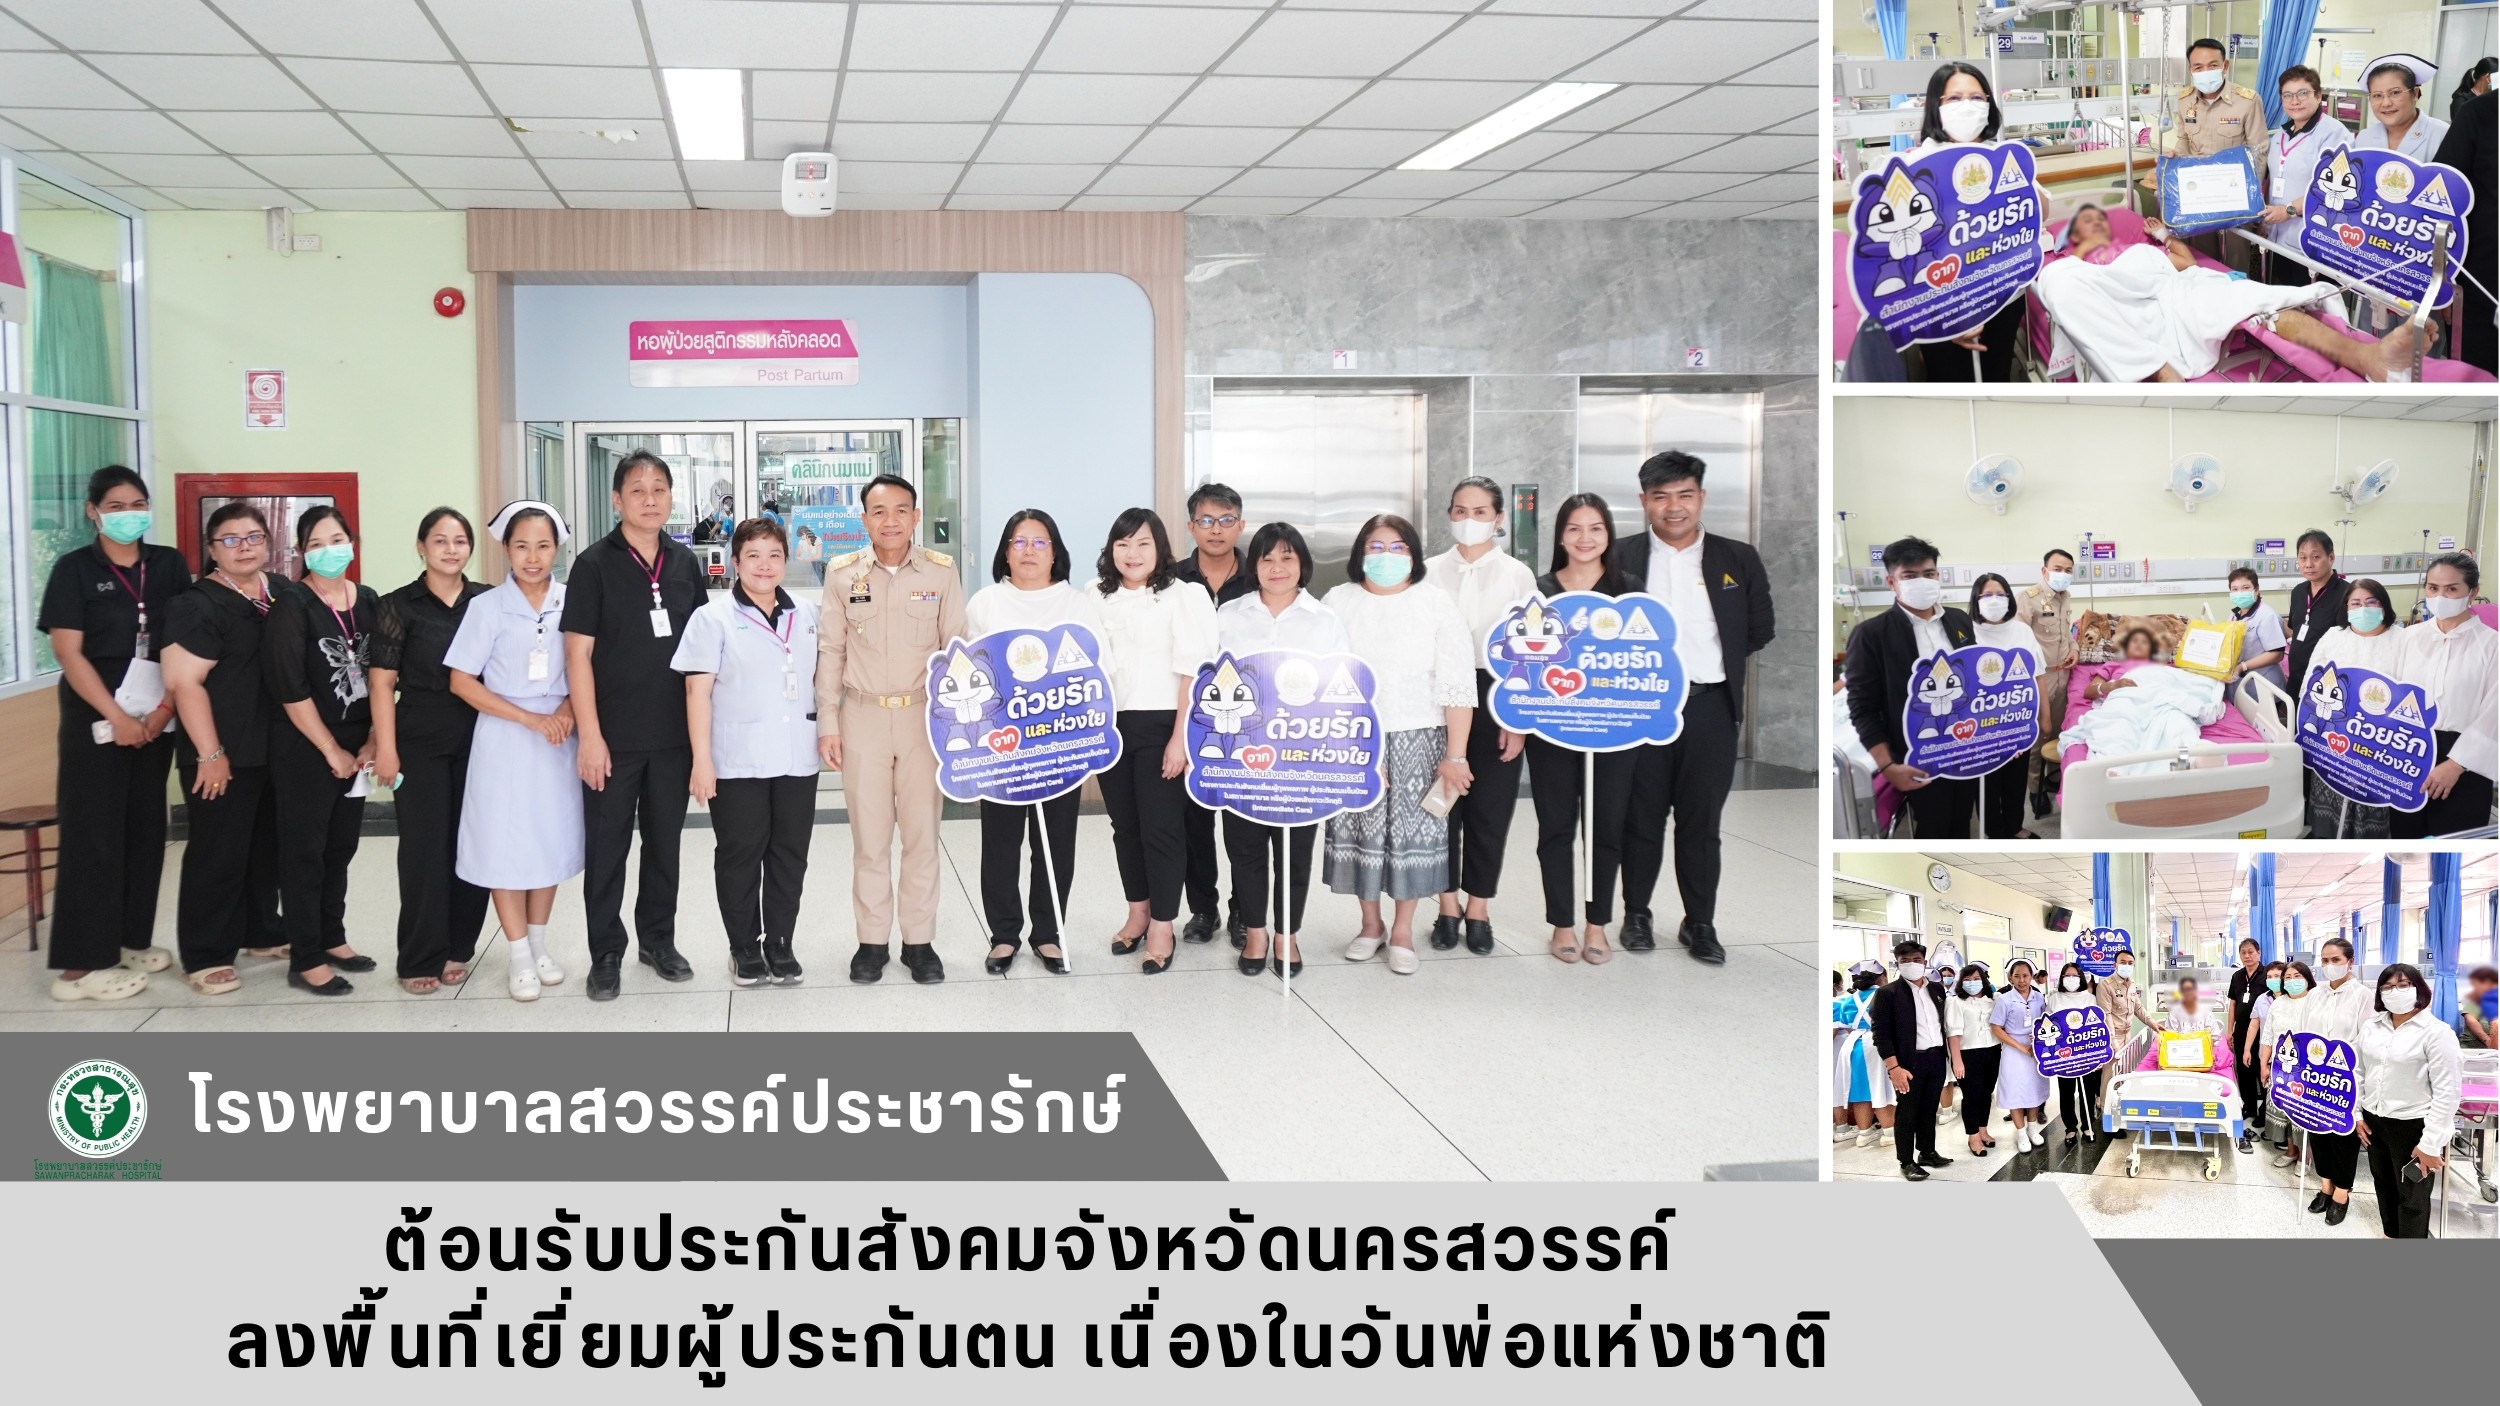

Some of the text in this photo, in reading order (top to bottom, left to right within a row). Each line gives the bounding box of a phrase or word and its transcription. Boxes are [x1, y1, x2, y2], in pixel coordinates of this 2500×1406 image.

[1999, 38, 2011, 48] 29
[1949, 196, 2034, 246] ด้วยรัก
[1965, 227, 2034, 264] และ ห่วงใย
[2342, 230, 2360, 241] จาก
[2368, 234, 2393, 251] และ
[1932, 264, 1955, 281] จาก
[637, 329, 841, 355] หอผู้ป่วยสูติกรรมหลังคลอด
[1342, 353, 1348, 367] 1
[1694, 351, 1703, 366] 2
[758, 369, 843, 381] Post Partum
[791, 457, 873, 479] คลินิกนมแม่
[1578, 645, 1663, 670] ด้วยรัก
[1552, 677, 1575, 689] จาก
[1591, 672, 1669, 692] และ ห่วงใย
[1006, 675, 1103, 719] ด้วยรัก
[1970, 684, 2033, 714] ด้วยรัก
[1025, 709, 1106, 738] และ ห่วงใย
[1266, 707, 1372, 740] ด้วยรัก
[1980, 708, 2032, 728] และ ห่วงใย
[1956, 724, 1973, 735] จาก
[2346, 712, 2427, 757] ด้วยรัก
[993, 733, 1016, 747] จาก
[2330, 738, 2345, 748] จาก
[1247, 752, 1270, 764] จาก
[1281, 743, 1371, 765] และ ห่วงใย
[2352, 742, 2374, 757] และ
[2374, 747, 2421, 778] ห่วงใย
[2065, 1027, 2106, 1045] ด้วยรัก
[2301, 1064, 2352, 1092] ด้วยรัก
[2305, 1087, 2320, 1098] และ
[2320, 1089, 2349, 1109] ห่วงใย
